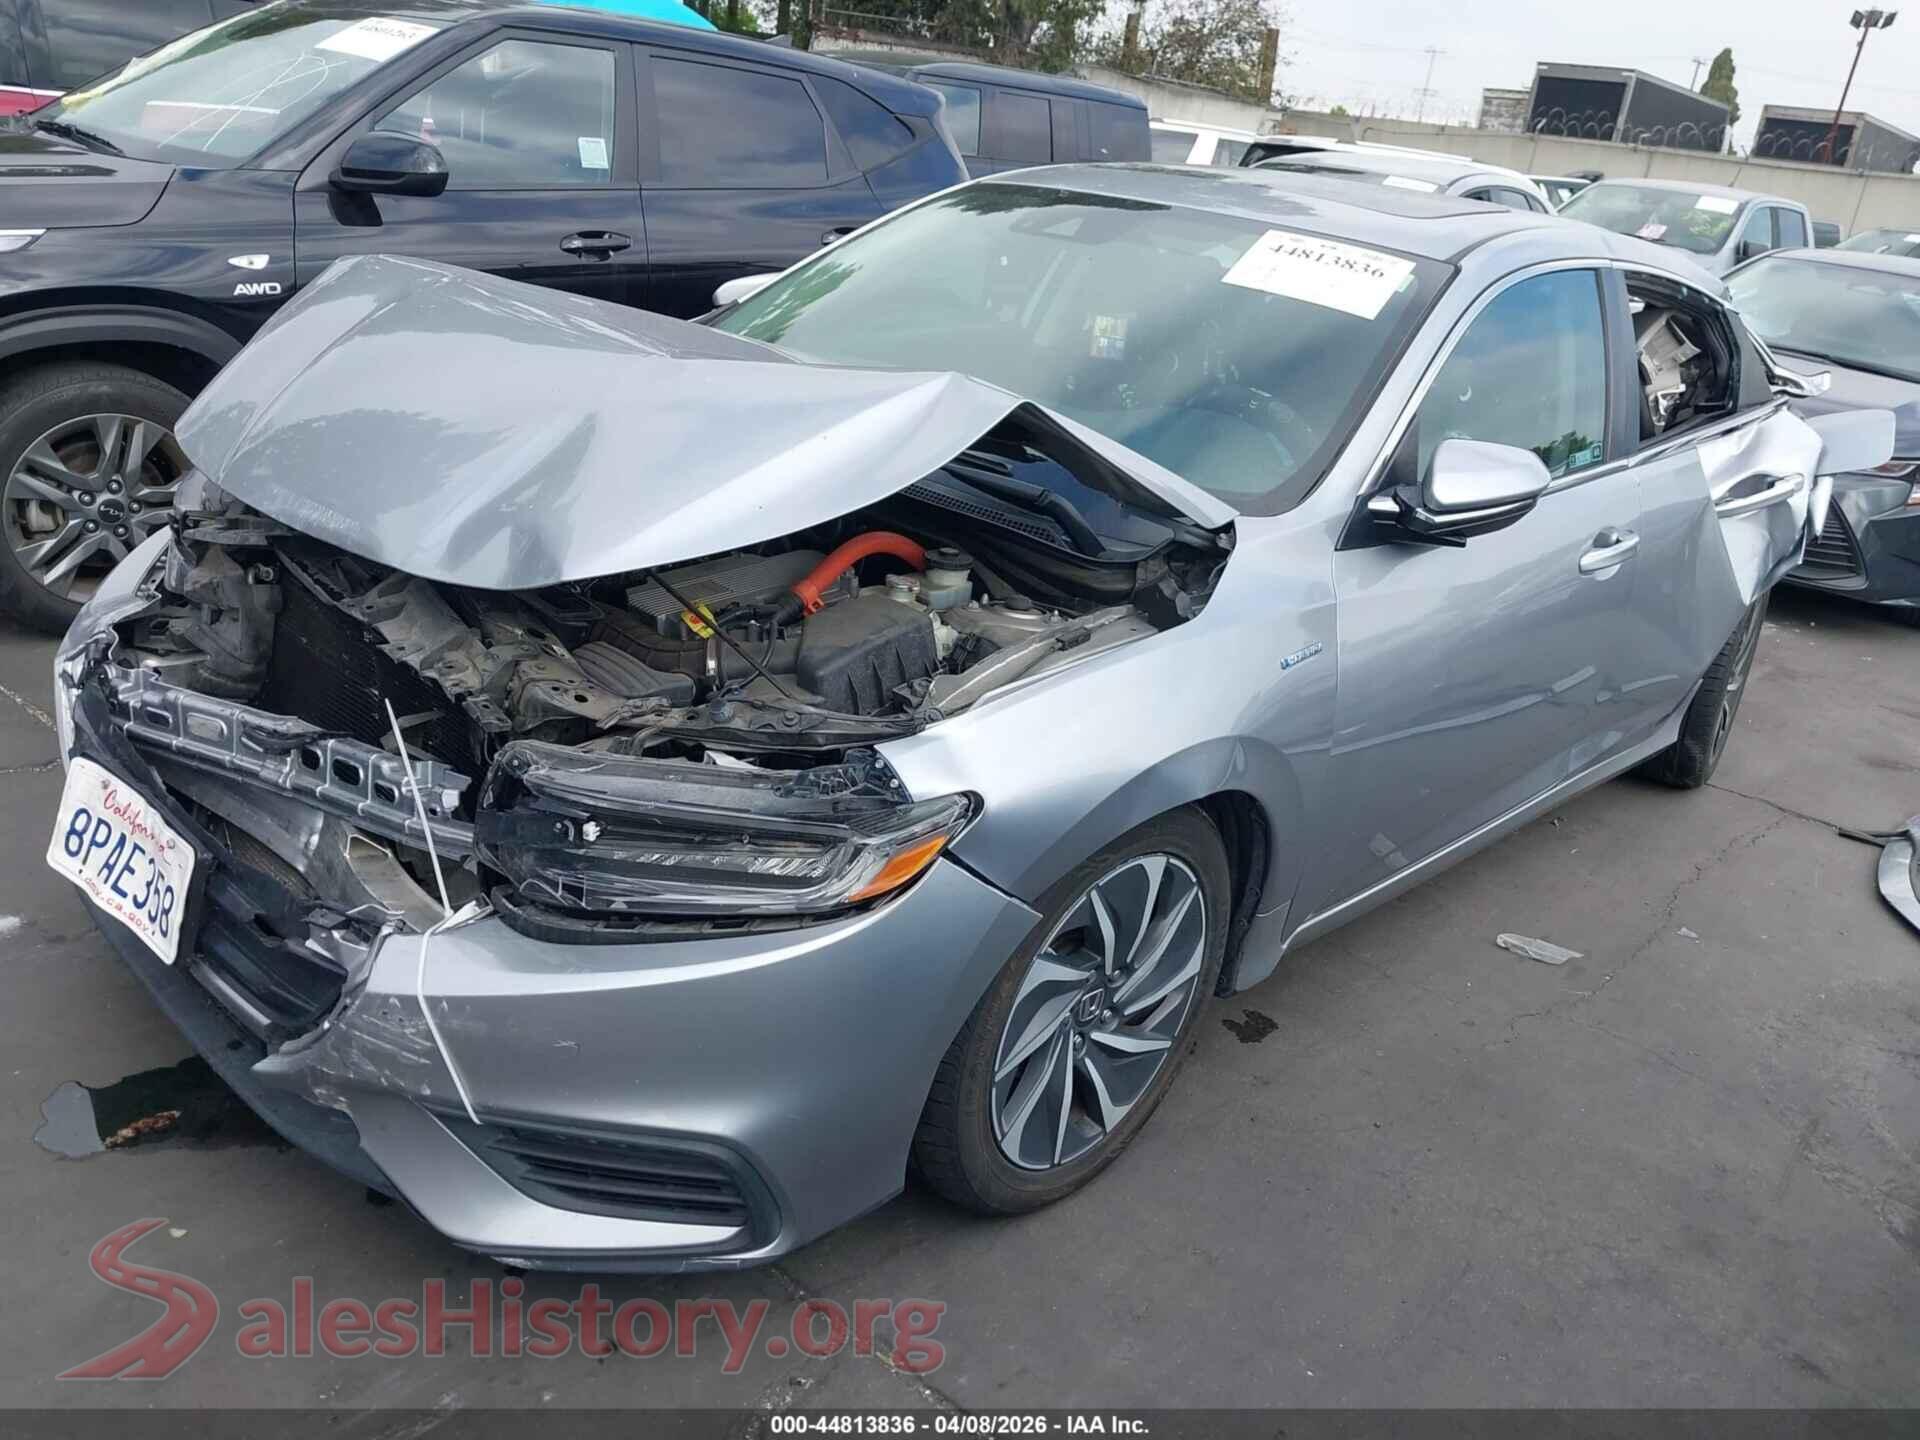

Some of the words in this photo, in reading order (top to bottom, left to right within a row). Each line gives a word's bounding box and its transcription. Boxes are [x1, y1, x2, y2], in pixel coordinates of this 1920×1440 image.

[1268, 243, 1385, 279] 44813836
[232, 282, 281, 296] AWD
[64, 807, 174, 938] 8PAE358
